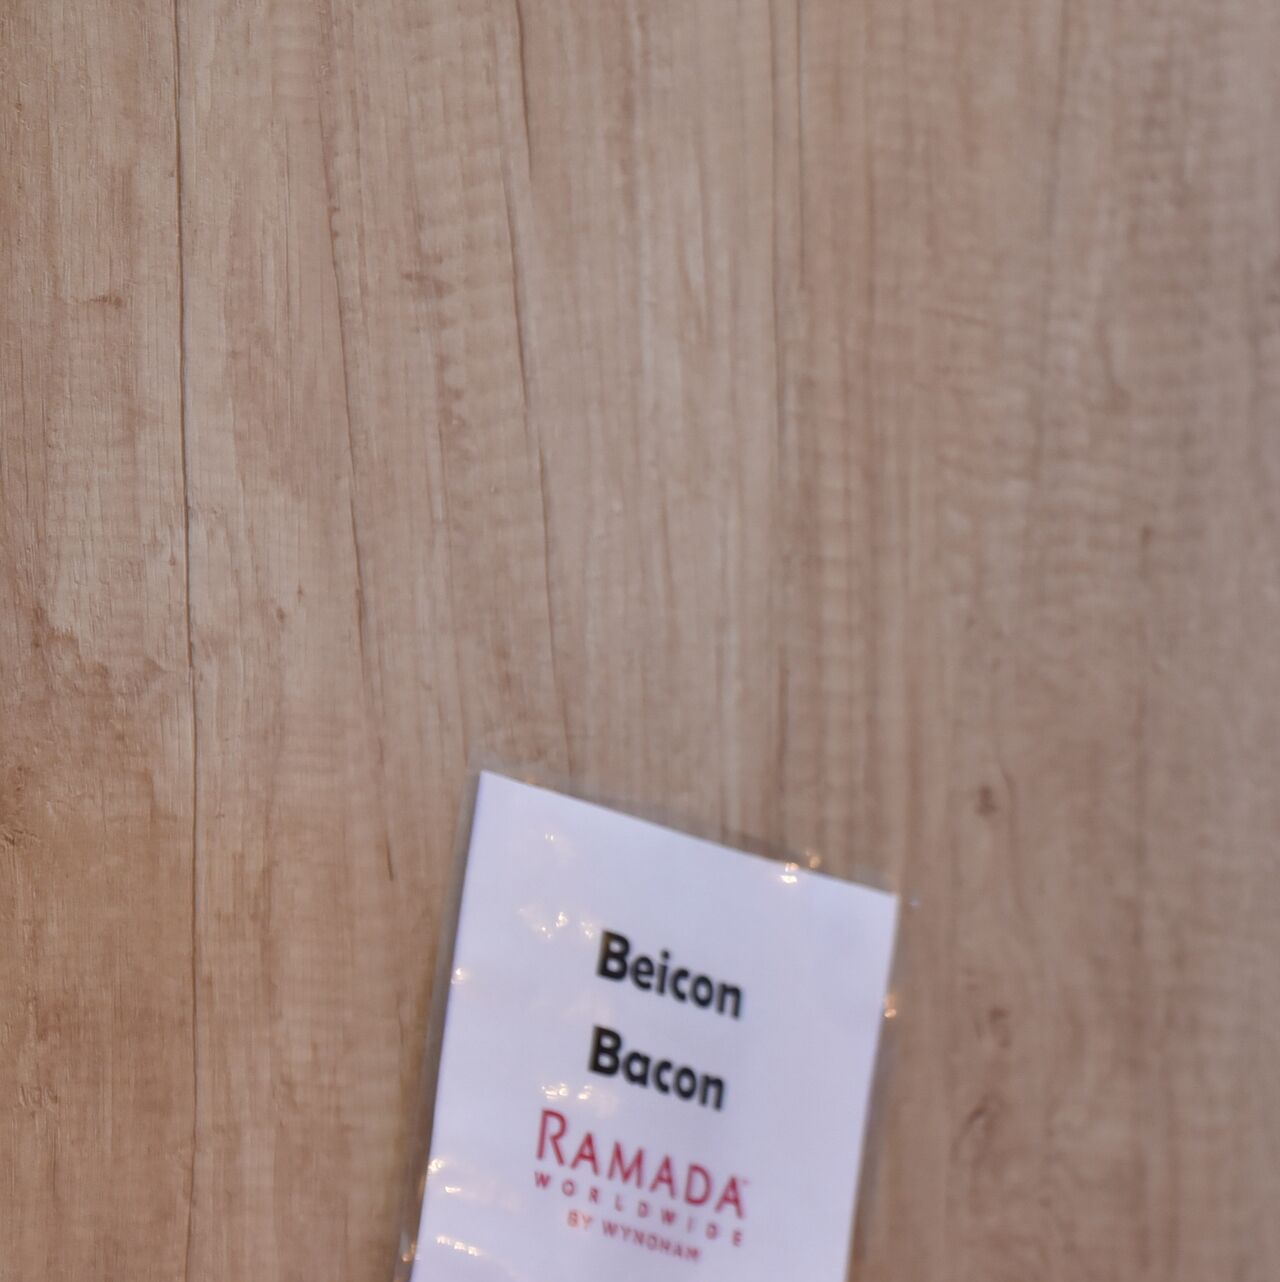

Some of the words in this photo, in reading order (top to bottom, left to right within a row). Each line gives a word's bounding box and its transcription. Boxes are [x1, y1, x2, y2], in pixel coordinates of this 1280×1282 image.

[597, 930, 744, 1019] Beicon
[588, 1025, 726, 1111] Bacon
[536, 1108, 746, 1220] RAMADA
[534, 1171, 744, 1247] WORLDWIDE
[567, 1210, 592, 1230] BY
[602, 1220, 702, 1261] WYNDHAM
